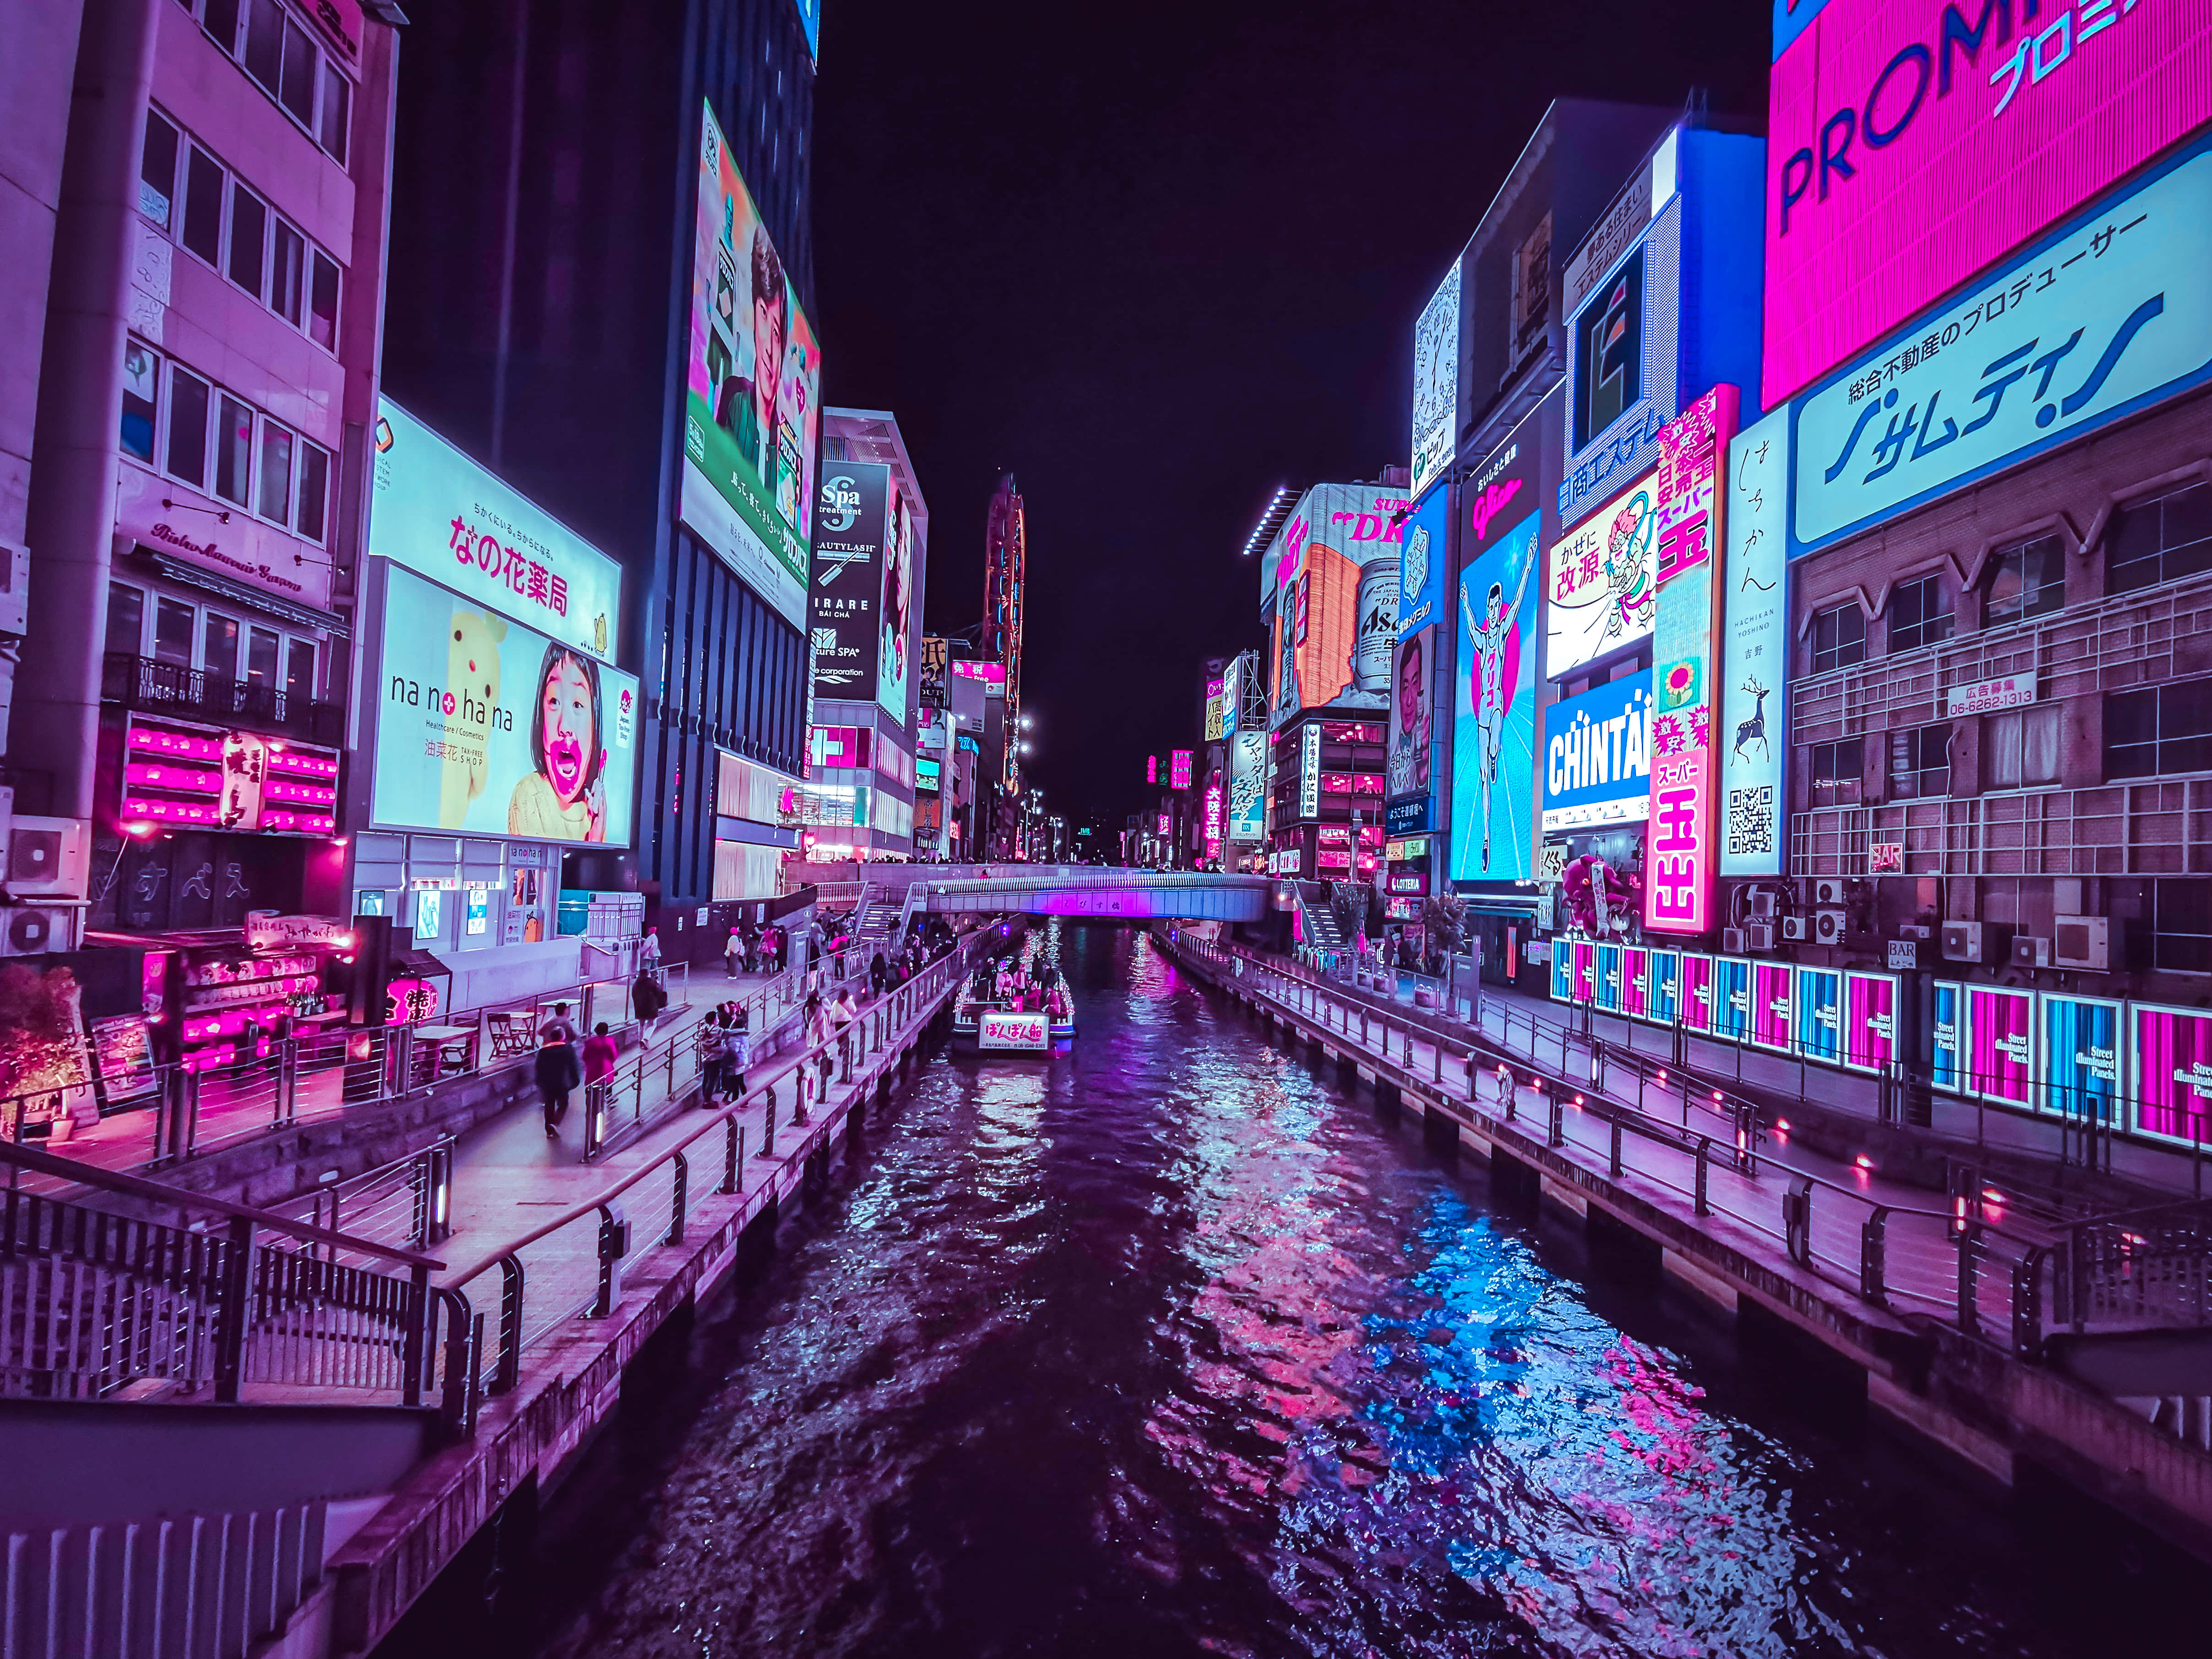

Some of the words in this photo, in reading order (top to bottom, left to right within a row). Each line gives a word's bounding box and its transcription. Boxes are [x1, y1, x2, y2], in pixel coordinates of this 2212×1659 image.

[1990, 0, 2136, 118] プロミ
[1780, 0, 2036, 237] PROM
[1847, 214, 2147, 405] 総合不動産のプロデューサー
[1478, 443, 1518, 492] おいしさと健康
[821, 484, 860, 509] Spa
[819, 505, 862, 516] treatment
[1473, 479, 1522, 541] Glico
[1657, 487, 1713, 531] スーパー
[474, 502, 554, 562] ちかくにいる。ちからになる。
[817, 542, 873, 553] AUTYLASH
[1561, 530, 1597, 566] かぜに
[449, 515, 568, 618] なの花薬局
[1557, 547, 1601, 601] 改源
[1398, 600, 1431, 635] 雪印メグミルク
[1734, 608, 1775, 628] HACHIKAN
[1738, 622, 1770, 638] YOSHINO
[1744, 645, 1763, 660] 吉野
[820, 668, 863, 677] corporation
[954, 664, 982, 674] 免税
[1487, 648, 1496, 708] グリコ
[1966, 679, 2016, 700] 広告募集
[1950, 690, 2032, 715] 06-6262-1313
[426, 719, 455, 734] Healthcare
[459, 727, 484, 741] Cosmetics
[1214, 700, 1223, 737] 高収入
[424, 738, 458, 761] 油菜花
[1390, 749, 1411, 772] 今日から
[1241, 733, 1264, 795] シャッターは
[1657, 760, 1699, 787] スーパー
[1306, 772, 1316, 813] かに道楽
[1206, 787, 1221, 840] 大阪王将
[1654, 784, 1699, 923] 玉出
[1872, 845, 1901, 865] BAR
[1396, 878, 1419, 890] LOTTERIA
[1889, 943, 1915, 957] BAR
[1824, 1004, 1836, 1014] Street
[1877, 1012, 1891, 1023] Street
[985, 1022, 1042, 1042] ぽんぽん船
[1937, 1021, 1953, 1033] Street
[2008, 1032, 2026, 1045] Street
[2008, 1050, 2029, 1064] Panels.
[2091, 1045, 2113, 1060] Street
[2091, 1066, 2115, 1080] Panels.
